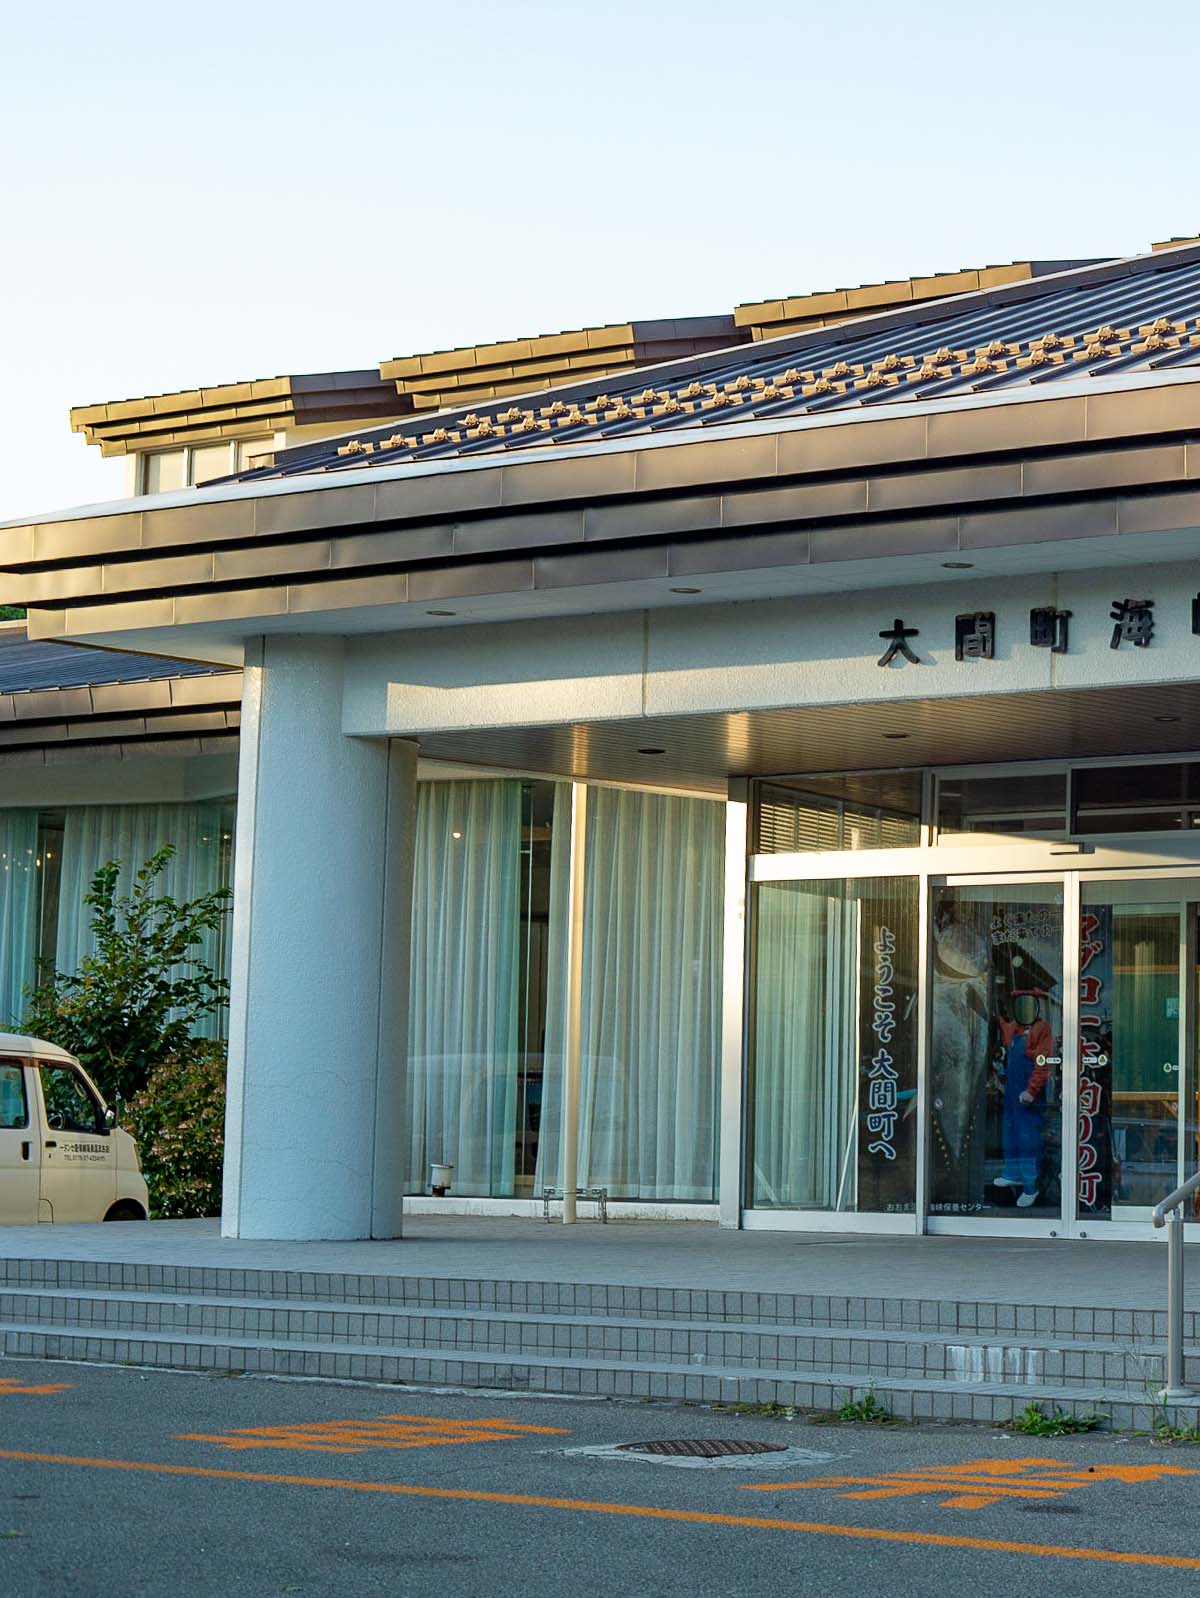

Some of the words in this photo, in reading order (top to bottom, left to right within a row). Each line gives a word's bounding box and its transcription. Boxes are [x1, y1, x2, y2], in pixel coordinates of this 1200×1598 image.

[872, 926, 897, 1042] ようこそ
[868, 1048, 898, 1160] 大間町へ
